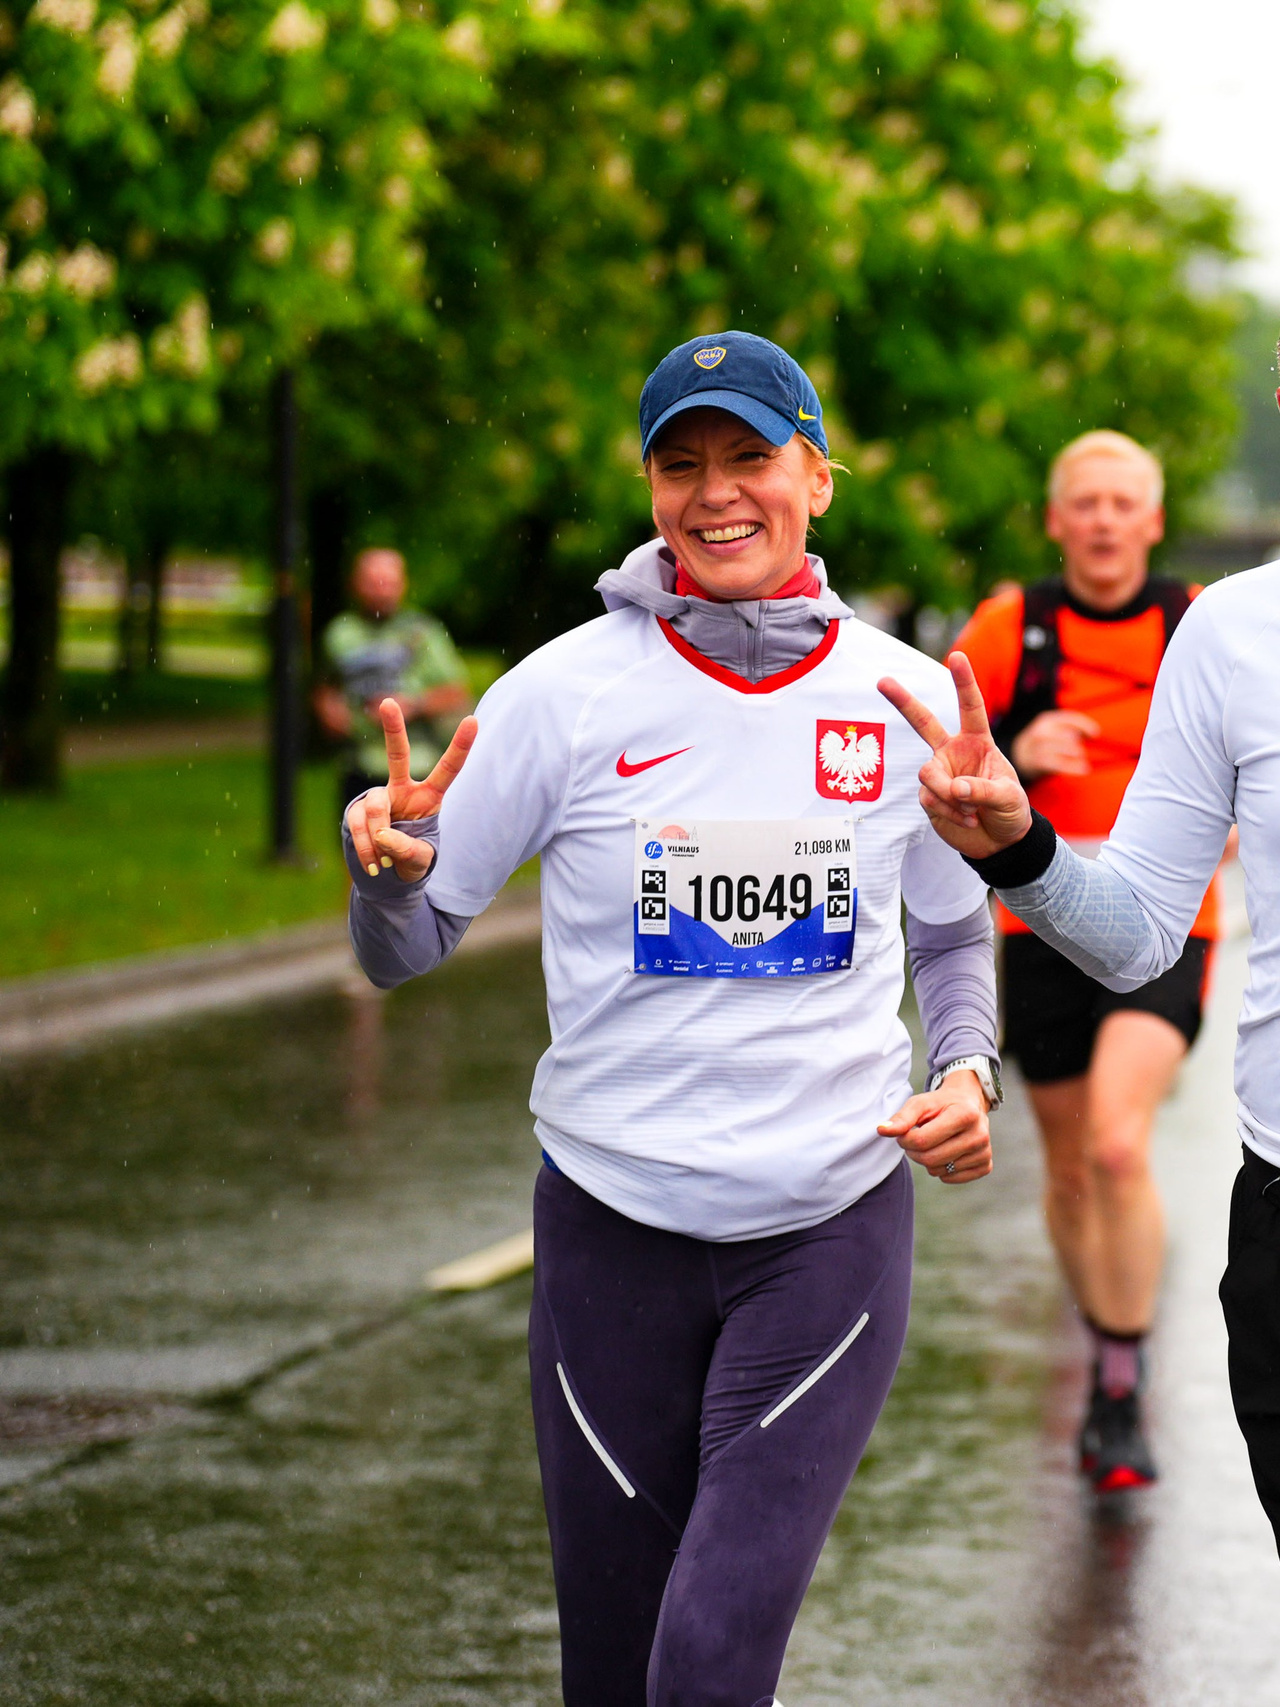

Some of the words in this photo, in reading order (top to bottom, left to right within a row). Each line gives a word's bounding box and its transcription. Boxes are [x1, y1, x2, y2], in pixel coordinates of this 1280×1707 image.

[667, 845, 699, 854] VILNIAUS
[794, 839, 832, 855] 21,098
[835, 839, 851, 853] KM
[688, 873, 813, 923] 10649
[732, 931, 765, 946] ANITA
